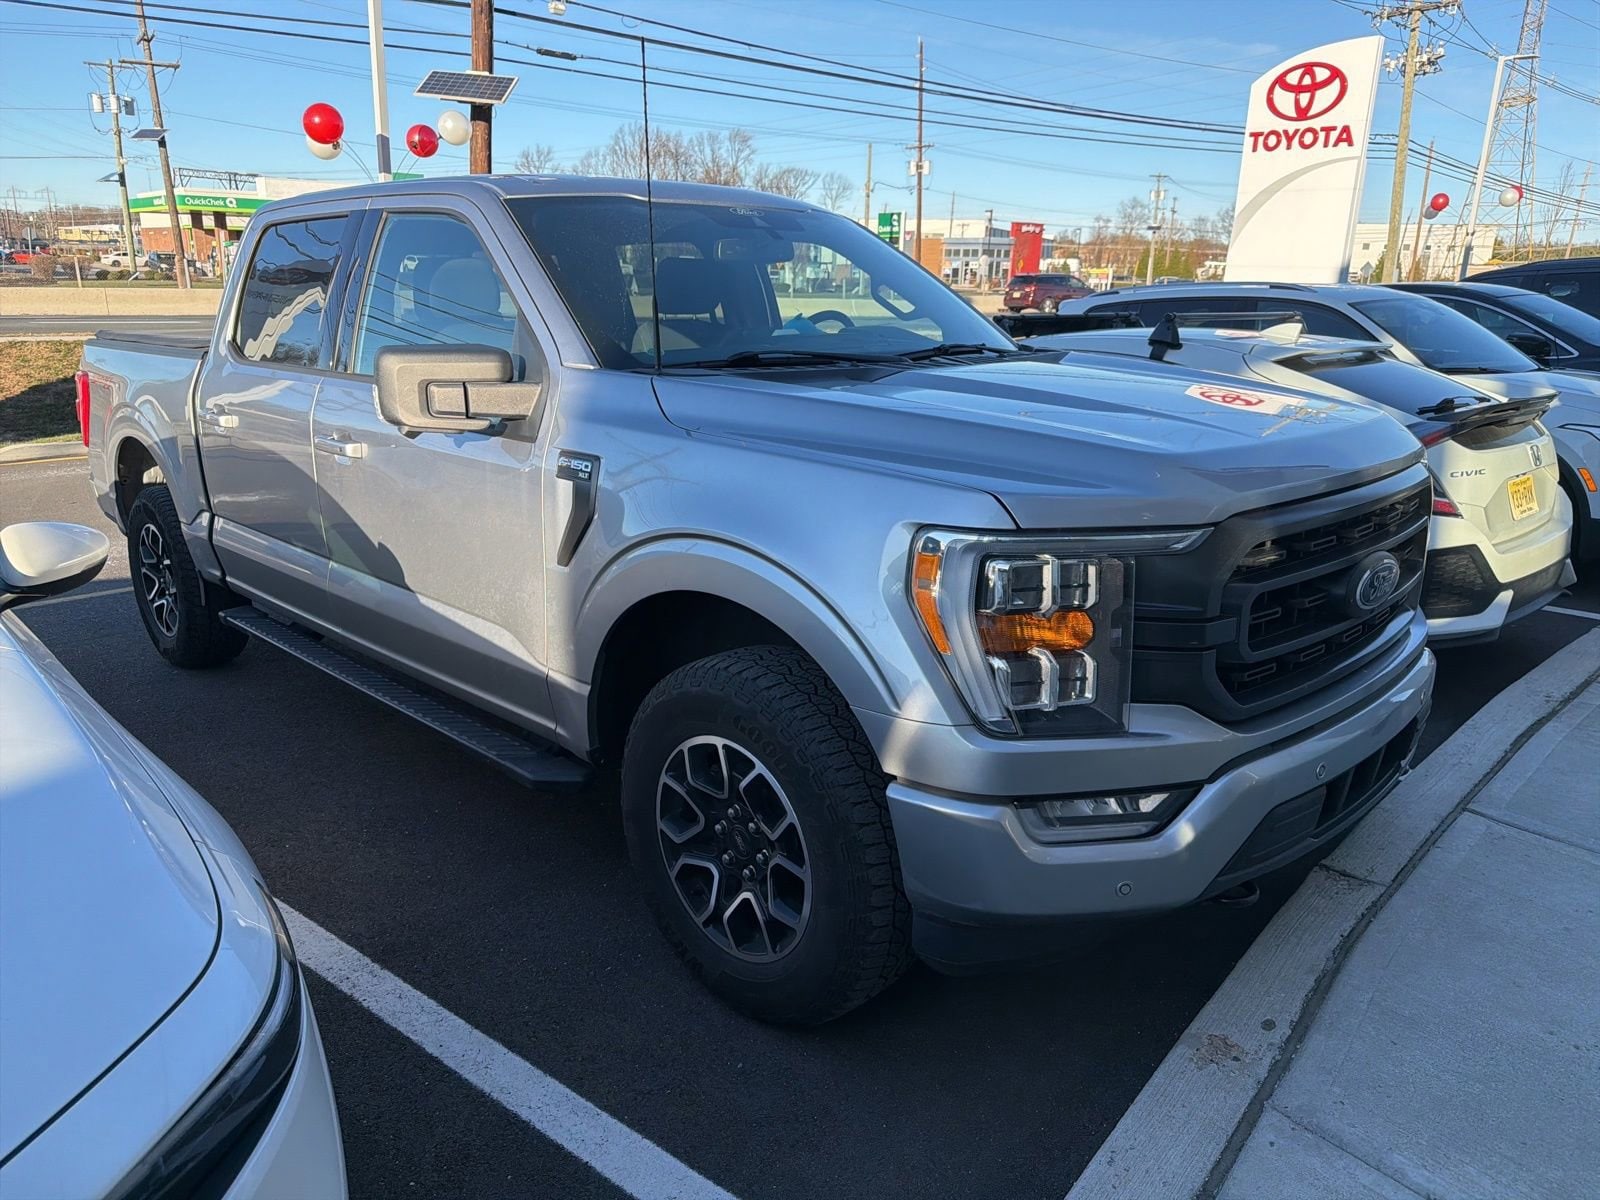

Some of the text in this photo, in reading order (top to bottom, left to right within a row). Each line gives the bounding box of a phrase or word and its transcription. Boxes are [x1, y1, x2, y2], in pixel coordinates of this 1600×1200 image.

[1249, 125, 1354, 152] TOYOTA
[185, 197, 224, 206] QuickChek
[1450, 468, 1486, 478] CIVIC
